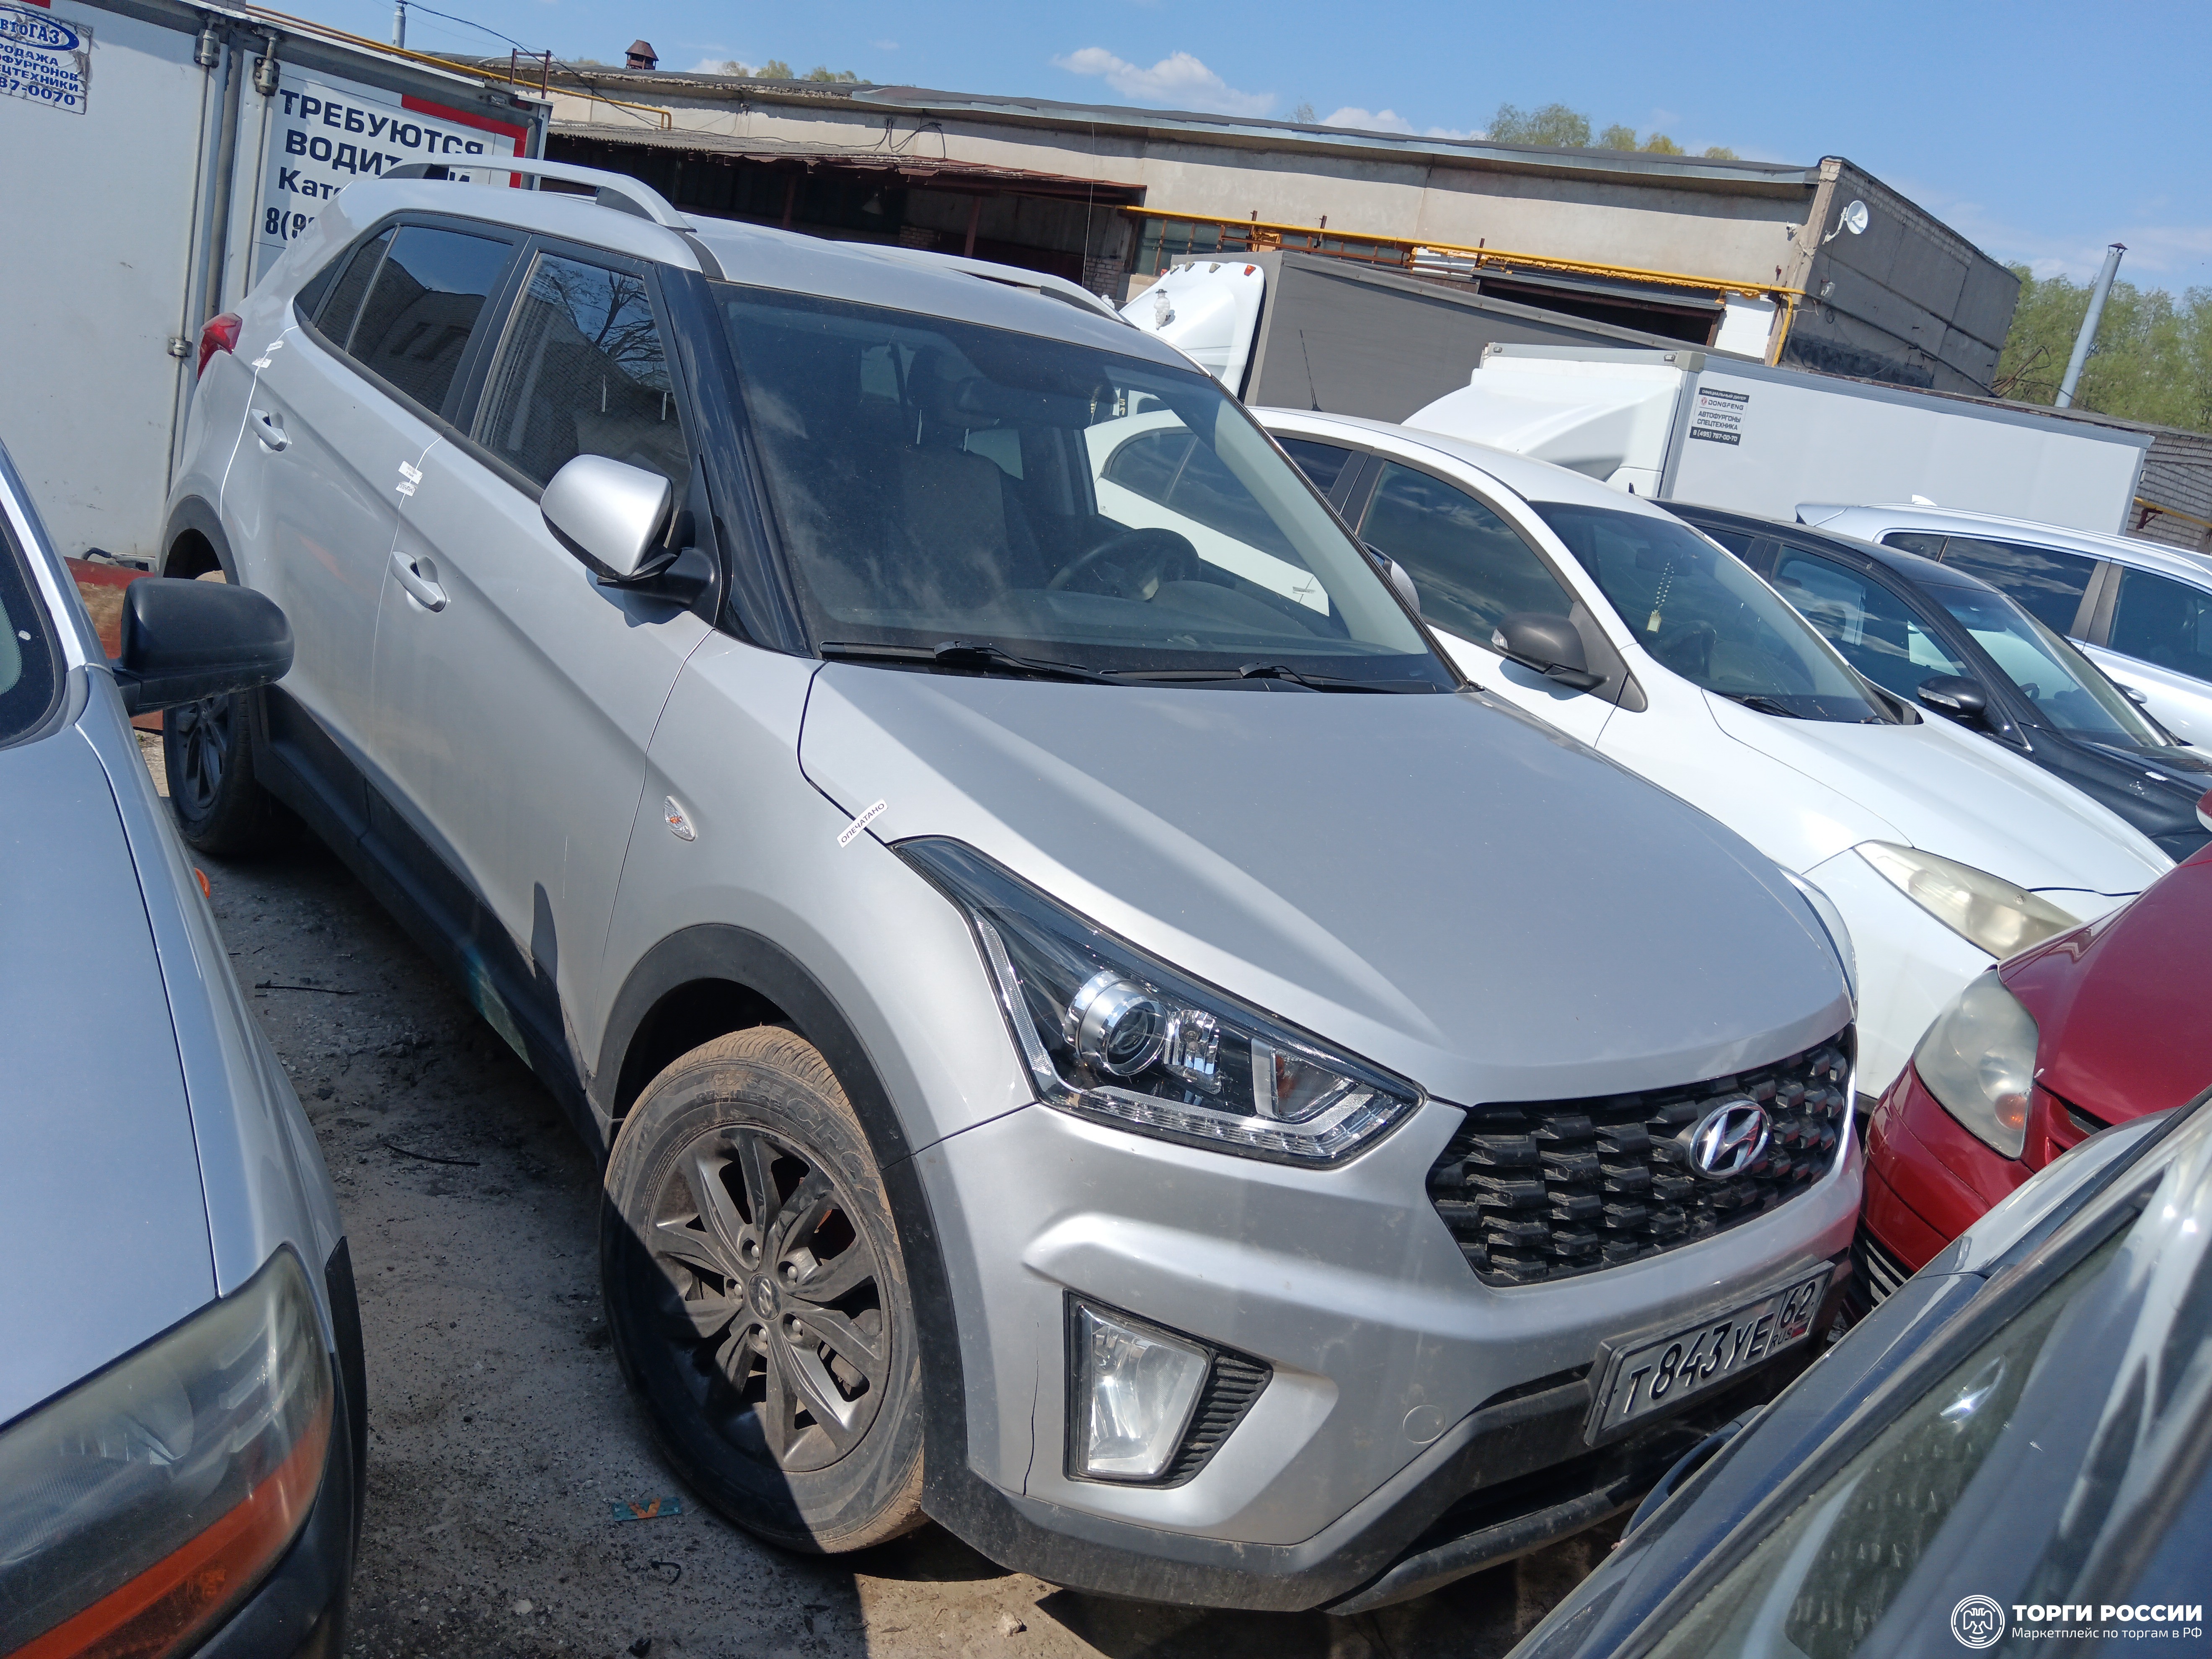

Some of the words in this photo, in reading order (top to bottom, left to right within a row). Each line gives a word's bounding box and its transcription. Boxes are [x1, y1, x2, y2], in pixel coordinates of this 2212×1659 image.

[0, 18, 59, 44] втоГАЗ
[0, 54, 78, 82] ФУРГОНОВ
[0, 64, 78, 92] ЦТЕХНИКИ
[279, 89, 484, 154] ТРЕБУЮТСЯ
[1698, 411, 1741, 423] АВТОФУРГОНЫ
[1708, 399, 1744, 411] DONGFENG
[1697, 419, 1738, 430] СПЕЦТЕХНИКА
[841, 804, 884, 842] ОПЕЧАТАНО
[713, 1074, 786, 1099] CLSSE
[1780, 1281, 1816, 1329] 62
[1769, 1326, 1792, 1349] RUS
